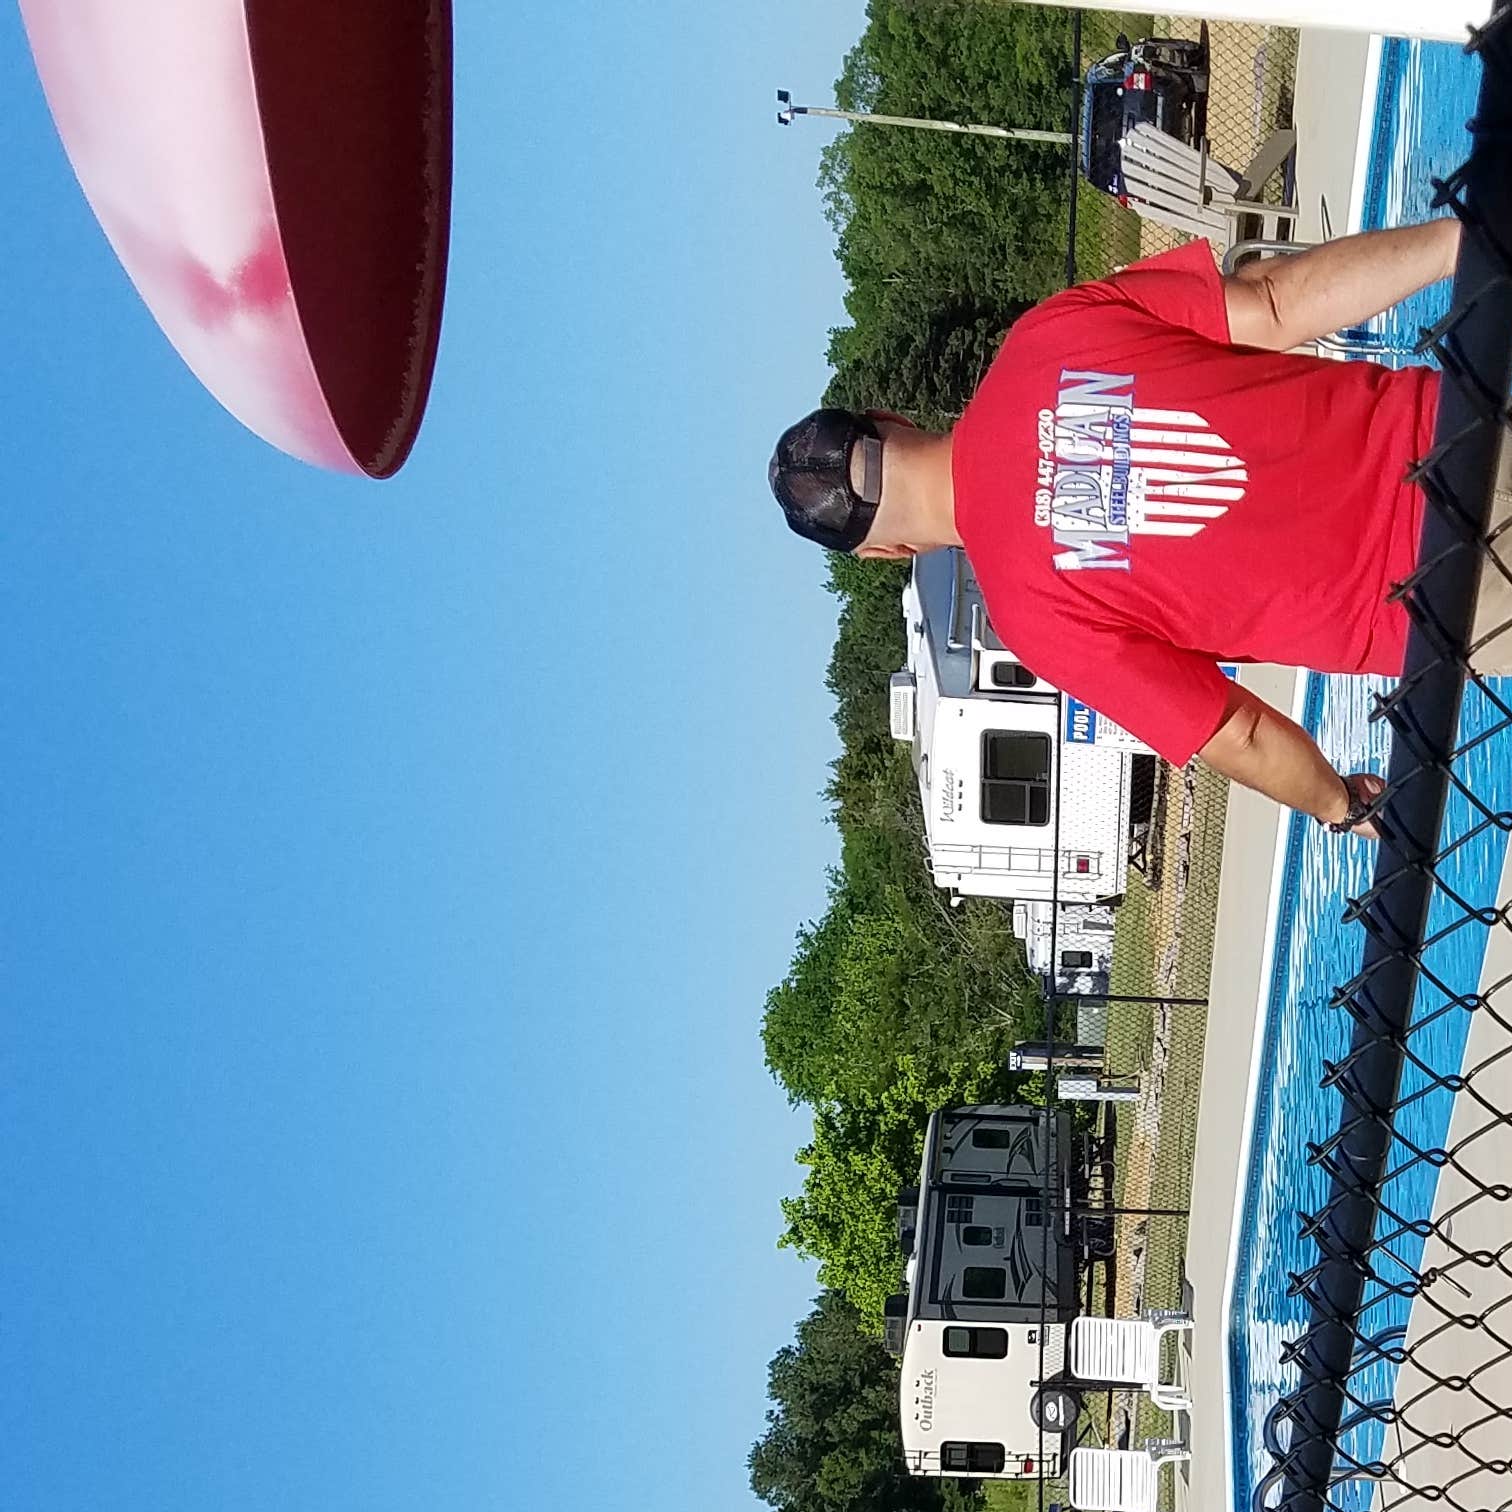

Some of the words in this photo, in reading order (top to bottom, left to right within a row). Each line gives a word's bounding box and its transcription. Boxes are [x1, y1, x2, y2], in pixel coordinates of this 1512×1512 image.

[1037, 408, 1054, 487] 447-0230
[1051, 368, 1134, 571] MADIGAN
[1111, 413, 1131, 484] BUILDINGS
[1034, 489, 1052, 526] (318)
[1108, 484, 1127, 524] STEEL
[1073, 708, 1090, 740] POOL
[940, 768, 954, 822] Wildcat
[920, 1369, 934, 1432] Outback
